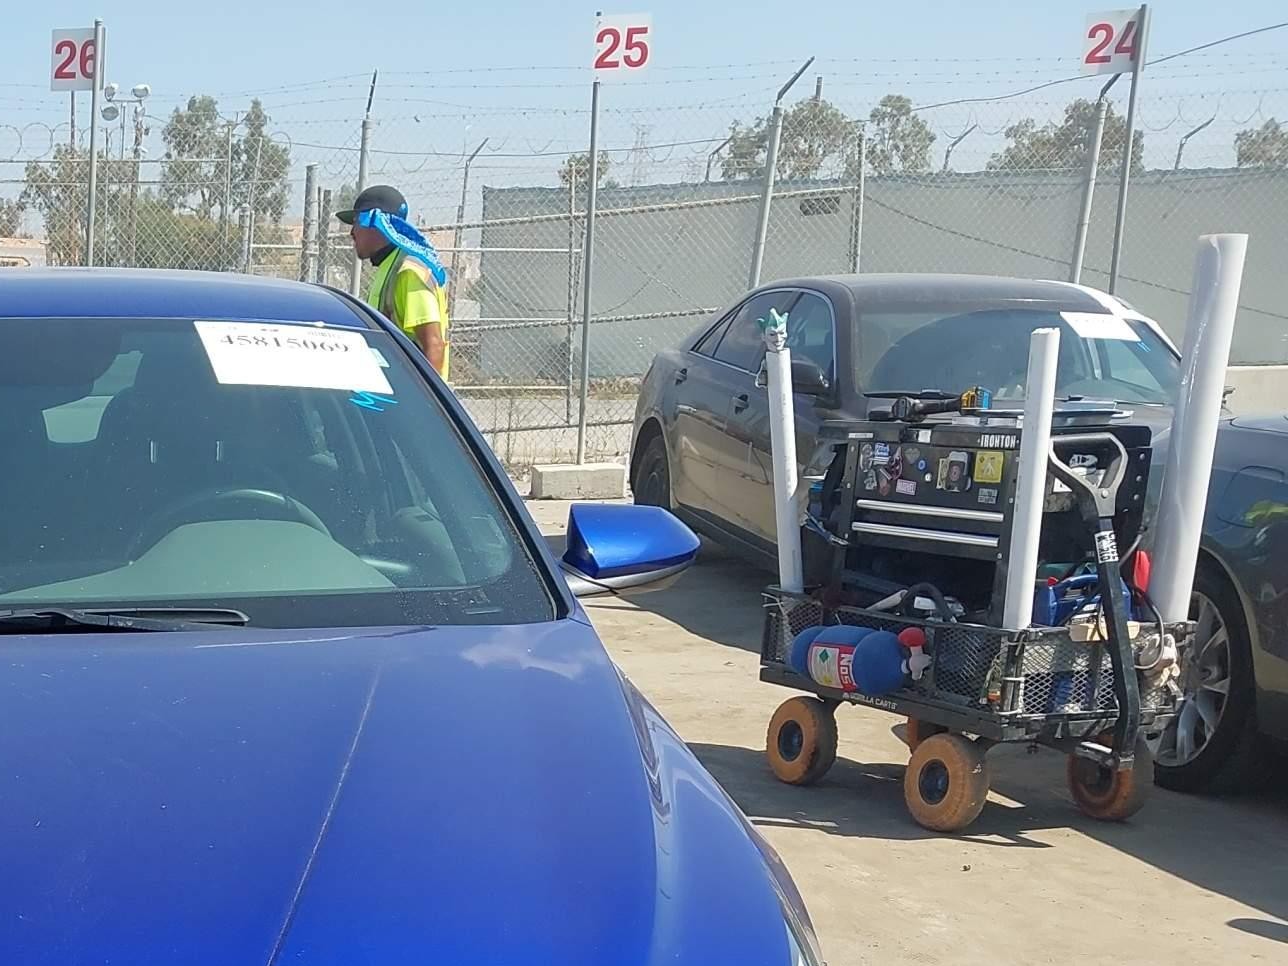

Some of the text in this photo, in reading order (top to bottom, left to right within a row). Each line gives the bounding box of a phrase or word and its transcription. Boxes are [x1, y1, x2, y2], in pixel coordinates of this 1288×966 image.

[53, 38, 97, 80] 26
[594, 26, 649, 69] 25
[1084, 20, 1139, 64] 24
[980, 434, 1016, 449] IRONTON
[839, 653, 855, 685] NOS
